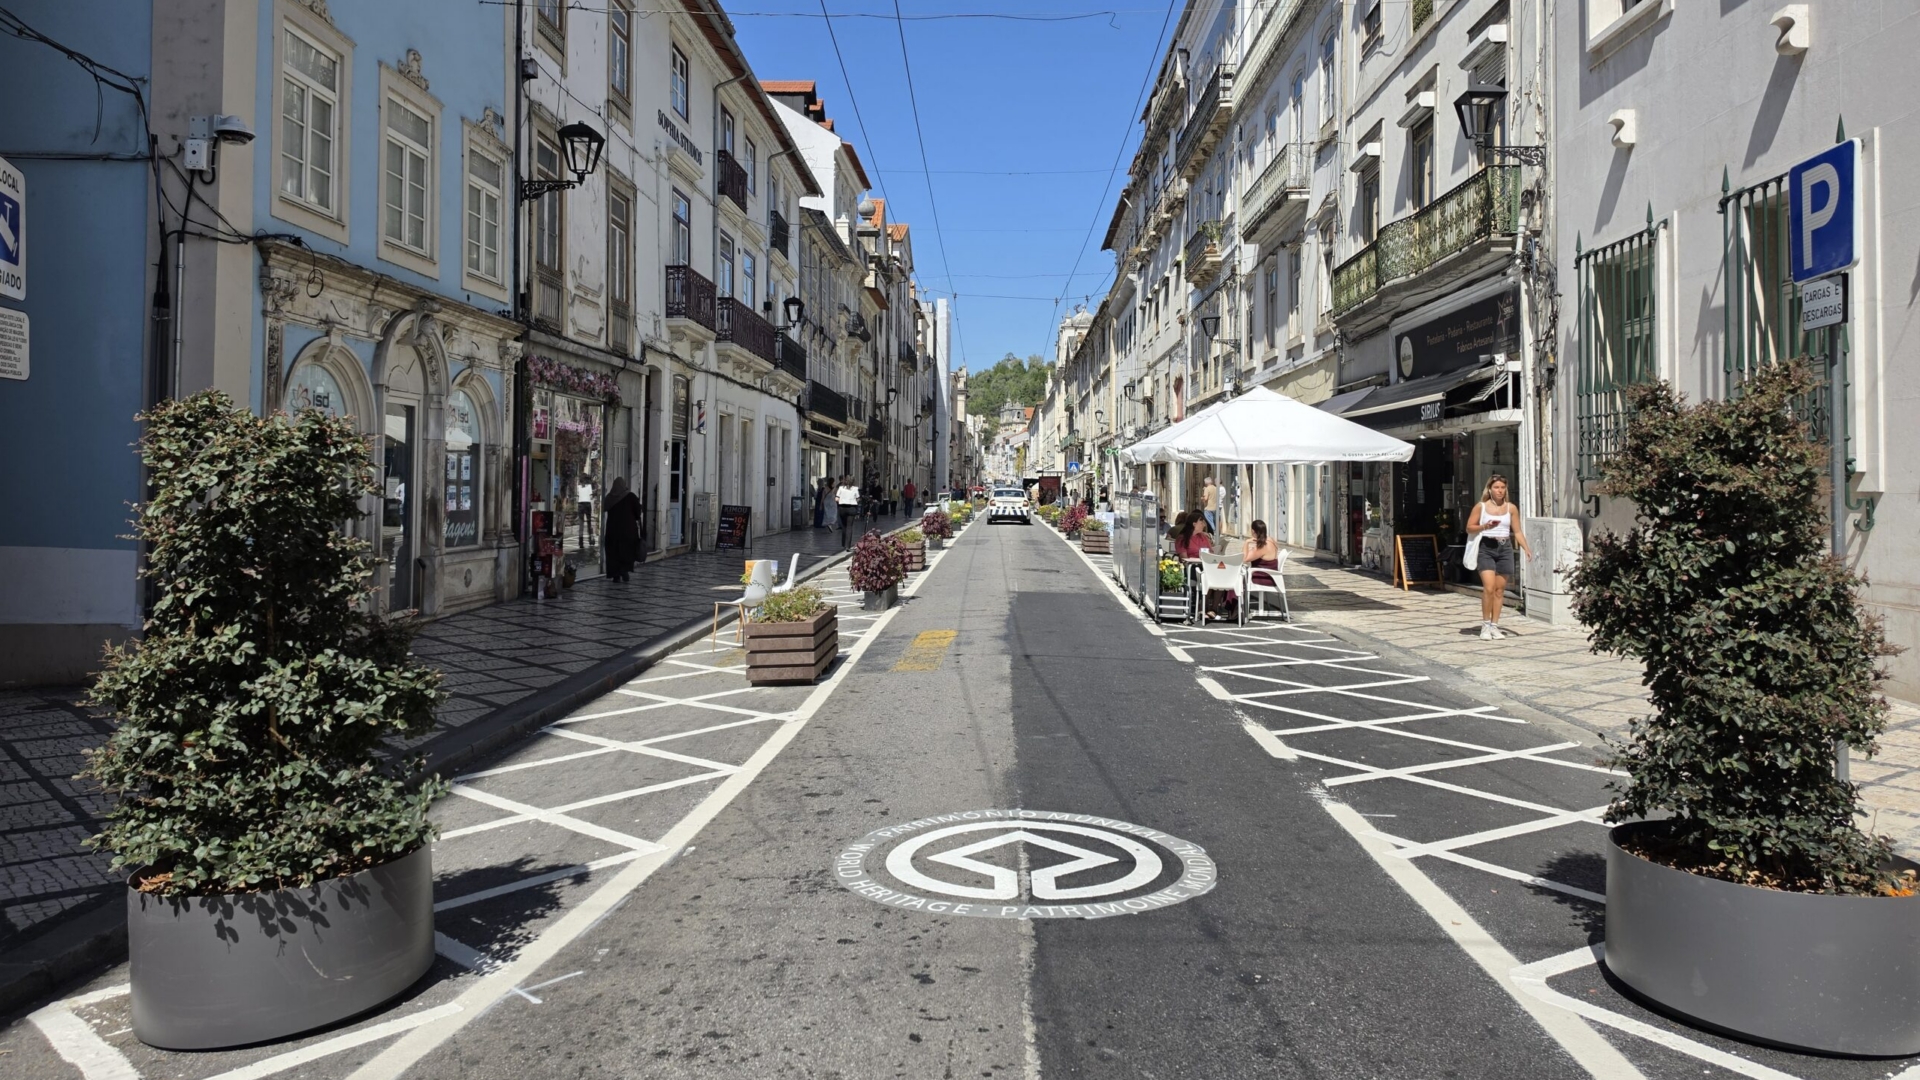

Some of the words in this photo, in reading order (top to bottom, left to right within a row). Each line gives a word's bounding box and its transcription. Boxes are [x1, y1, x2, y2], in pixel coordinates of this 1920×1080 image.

[658, 109, 679, 144] SOPHIA
[680, 132, 702, 166] STUDIOS
[1801, 162, 1840, 270] P
[1805, 286, 1831, 303] CARGAS
[1834, 283, 1840, 296] E
[1803, 303, 1842, 322] DESCARGAS
[1420, 402, 1440, 420] SIRIUS
[1047, 812, 1167, 841] MUNDIAL
[838, 843, 874, 877] WORLD
[848, 879, 974, 914] HERITAGE
[1000, 889, 1190, 916] PATRIMOINE
[1174, 844, 1212, 890] MONDIAL
